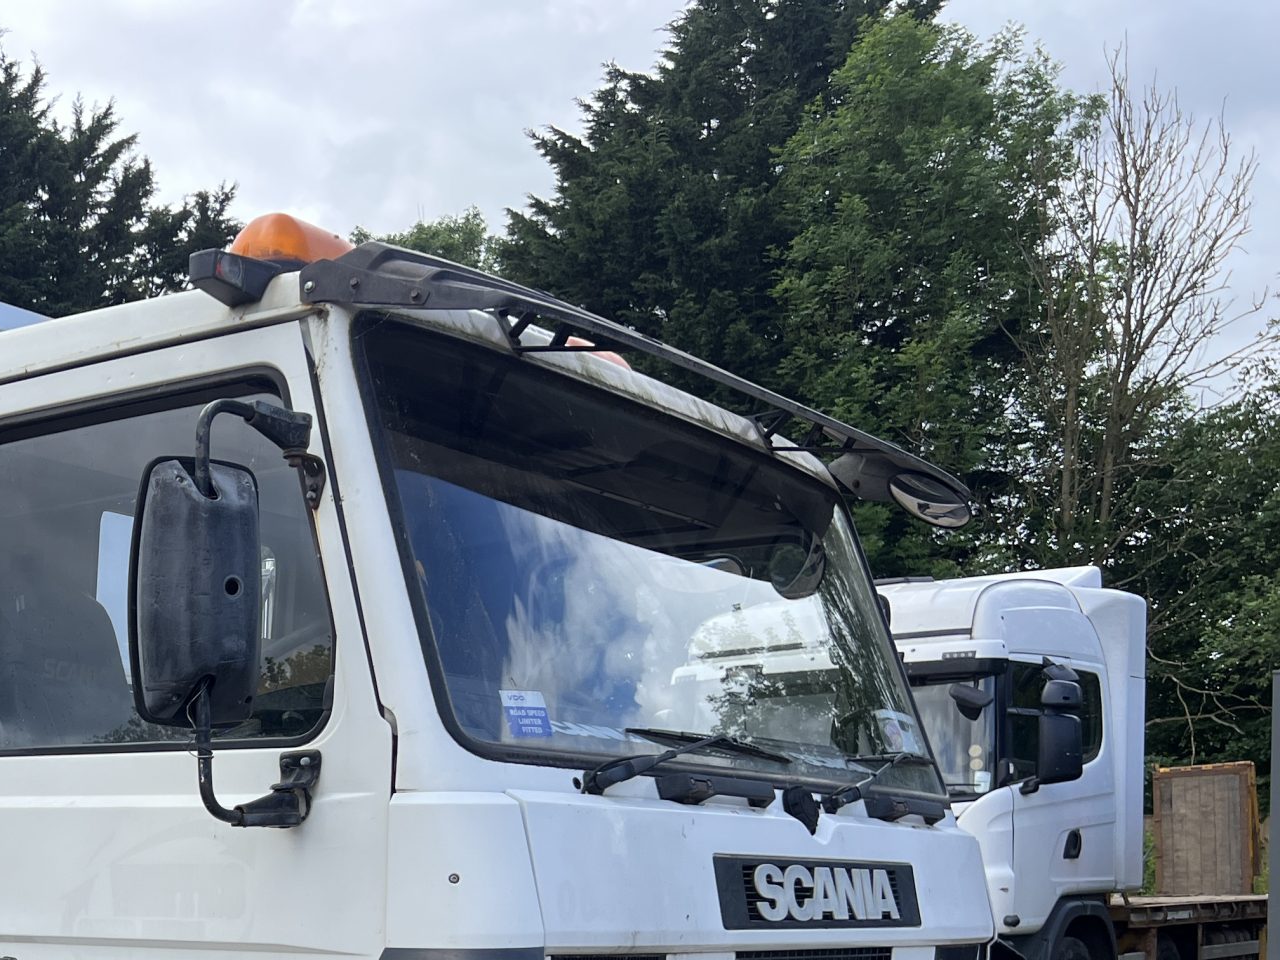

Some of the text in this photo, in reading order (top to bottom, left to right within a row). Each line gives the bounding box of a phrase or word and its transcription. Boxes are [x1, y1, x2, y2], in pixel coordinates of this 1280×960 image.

[507, 694, 526, 702] VDO
[509, 708, 546, 717] ROAD SPEED
[521, 726, 543, 734] FITTED
[754, 864, 901, 921] SCANIA
